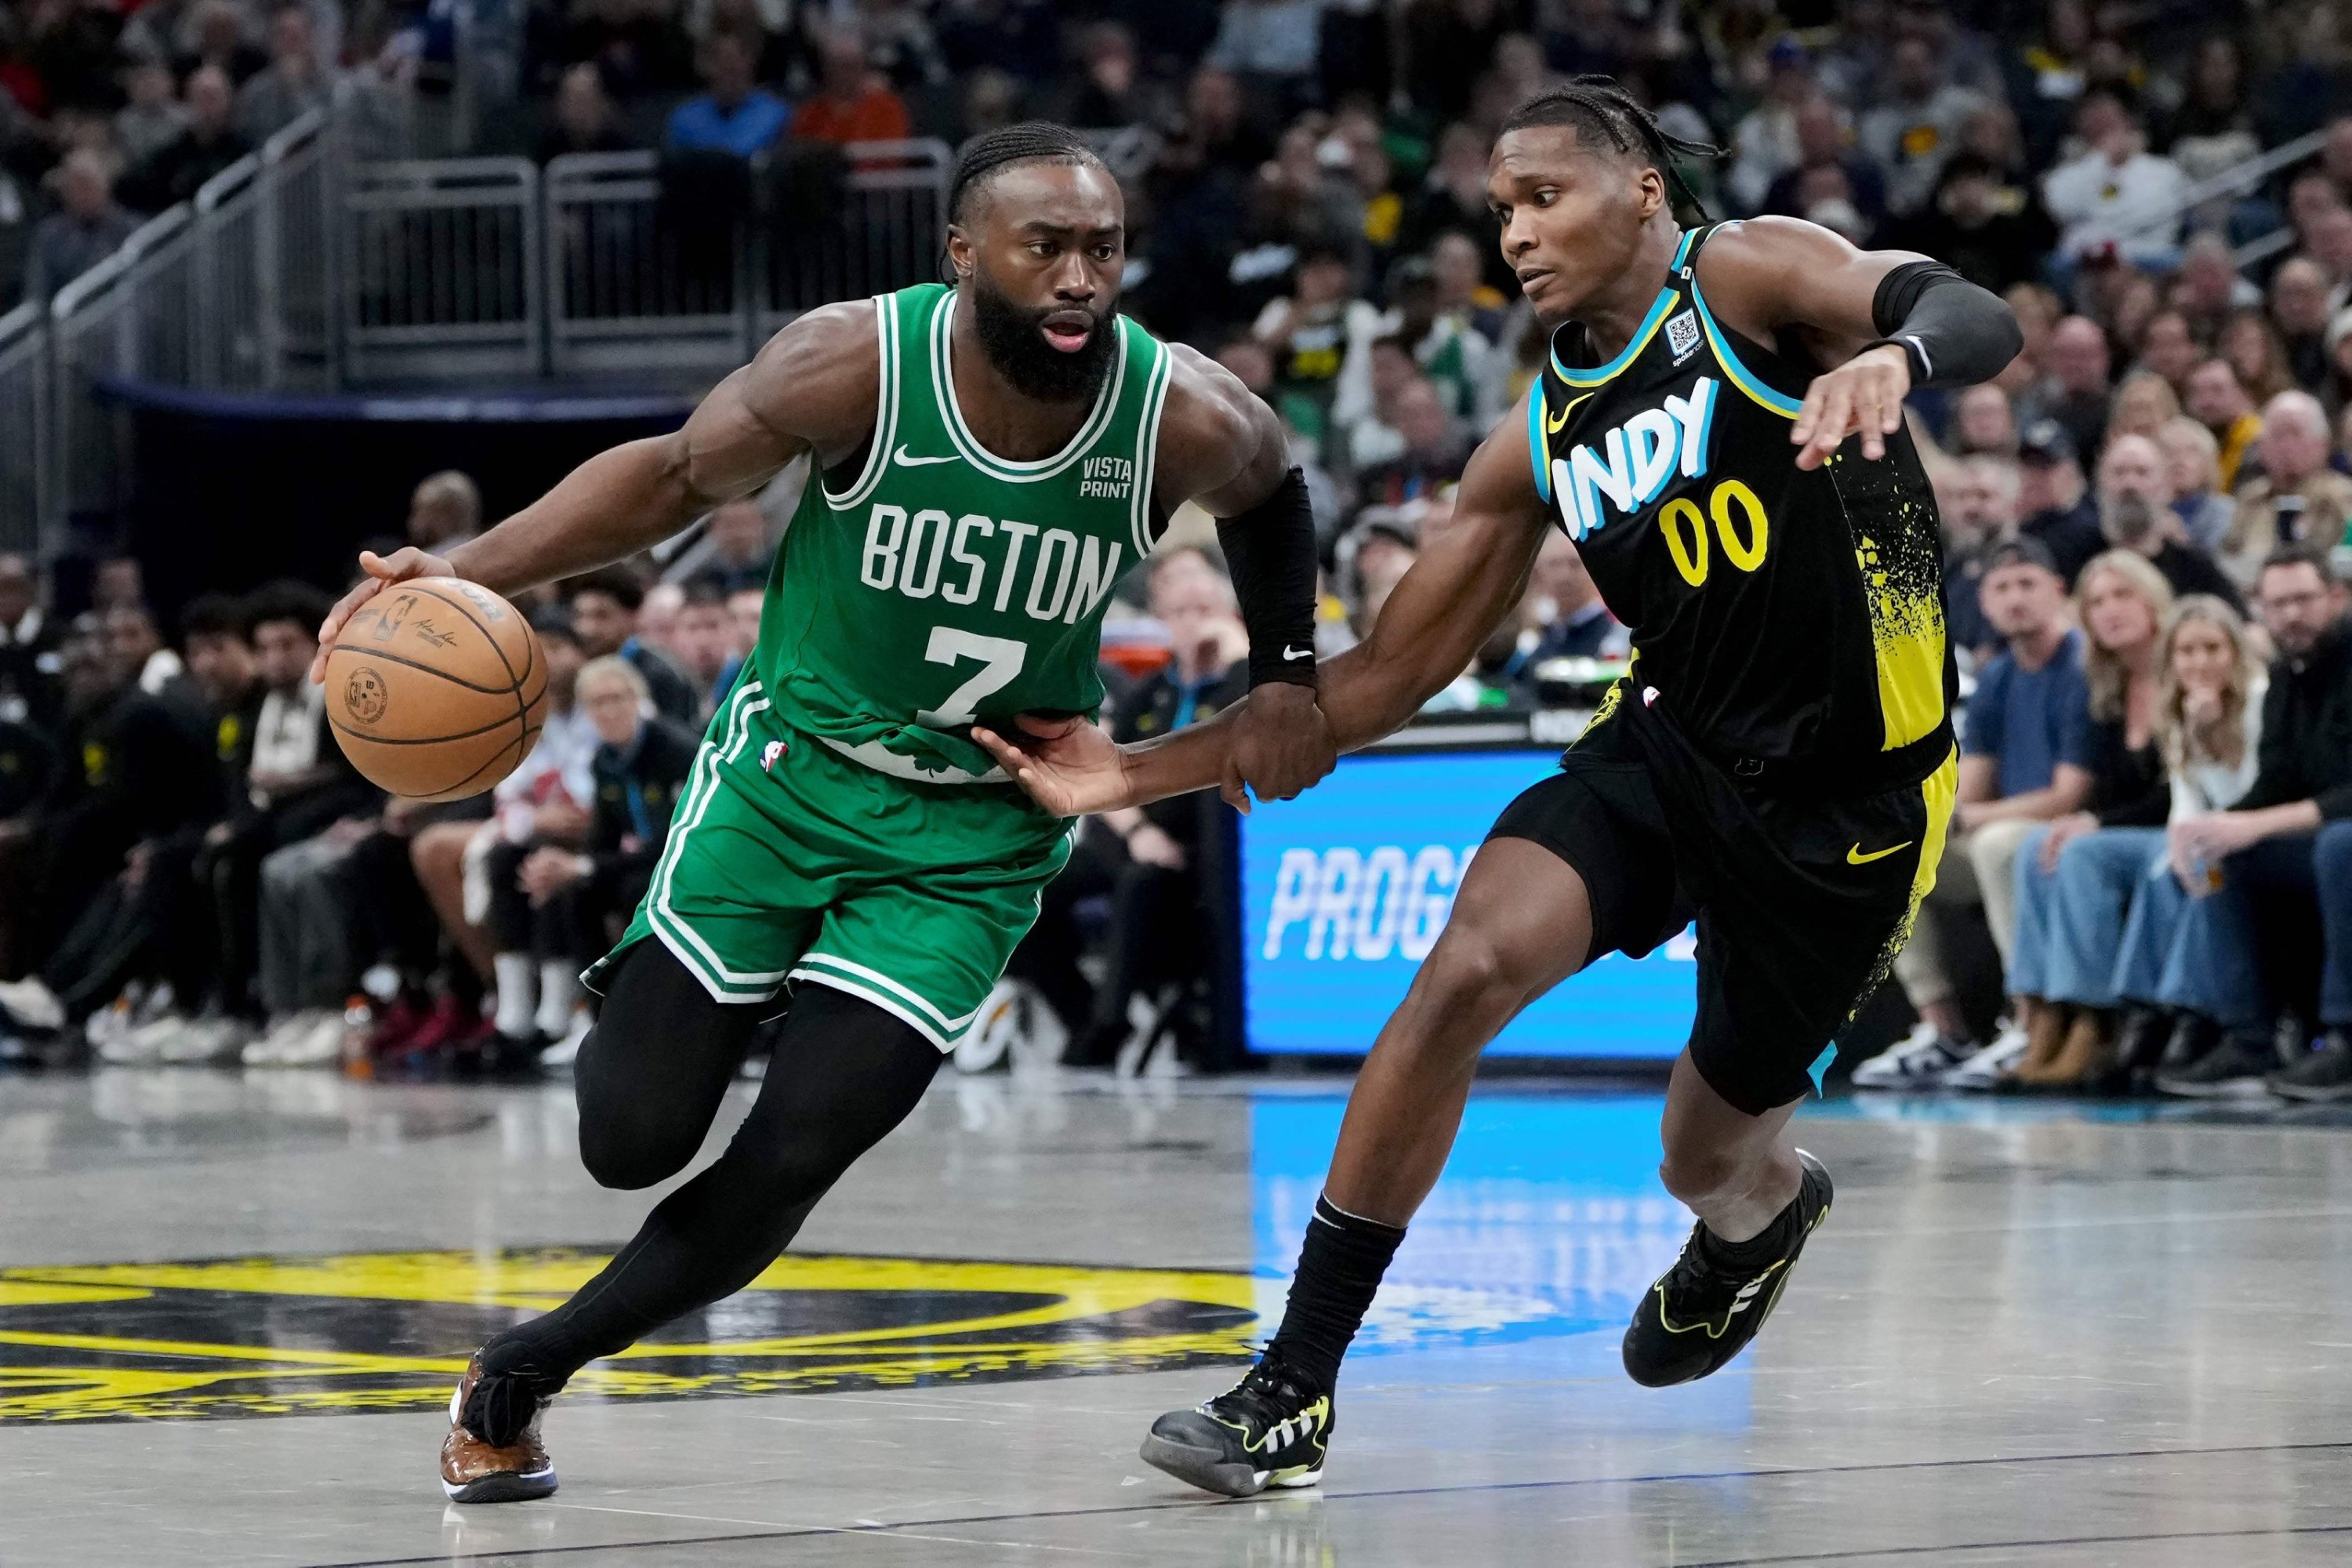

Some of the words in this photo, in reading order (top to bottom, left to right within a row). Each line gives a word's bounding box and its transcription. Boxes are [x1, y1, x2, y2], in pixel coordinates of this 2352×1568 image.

[1080, 481, 1131, 499] PRINT
[1083, 456, 1131, 482] VISTA
[1552, 376, 1720, 542] INDY
[861, 503, 1123, 625] BOSTON
[1658, 479, 1769, 587] 00
[917, 626, 1028, 728] 7
[1261, 844, 1480, 961] PROG
